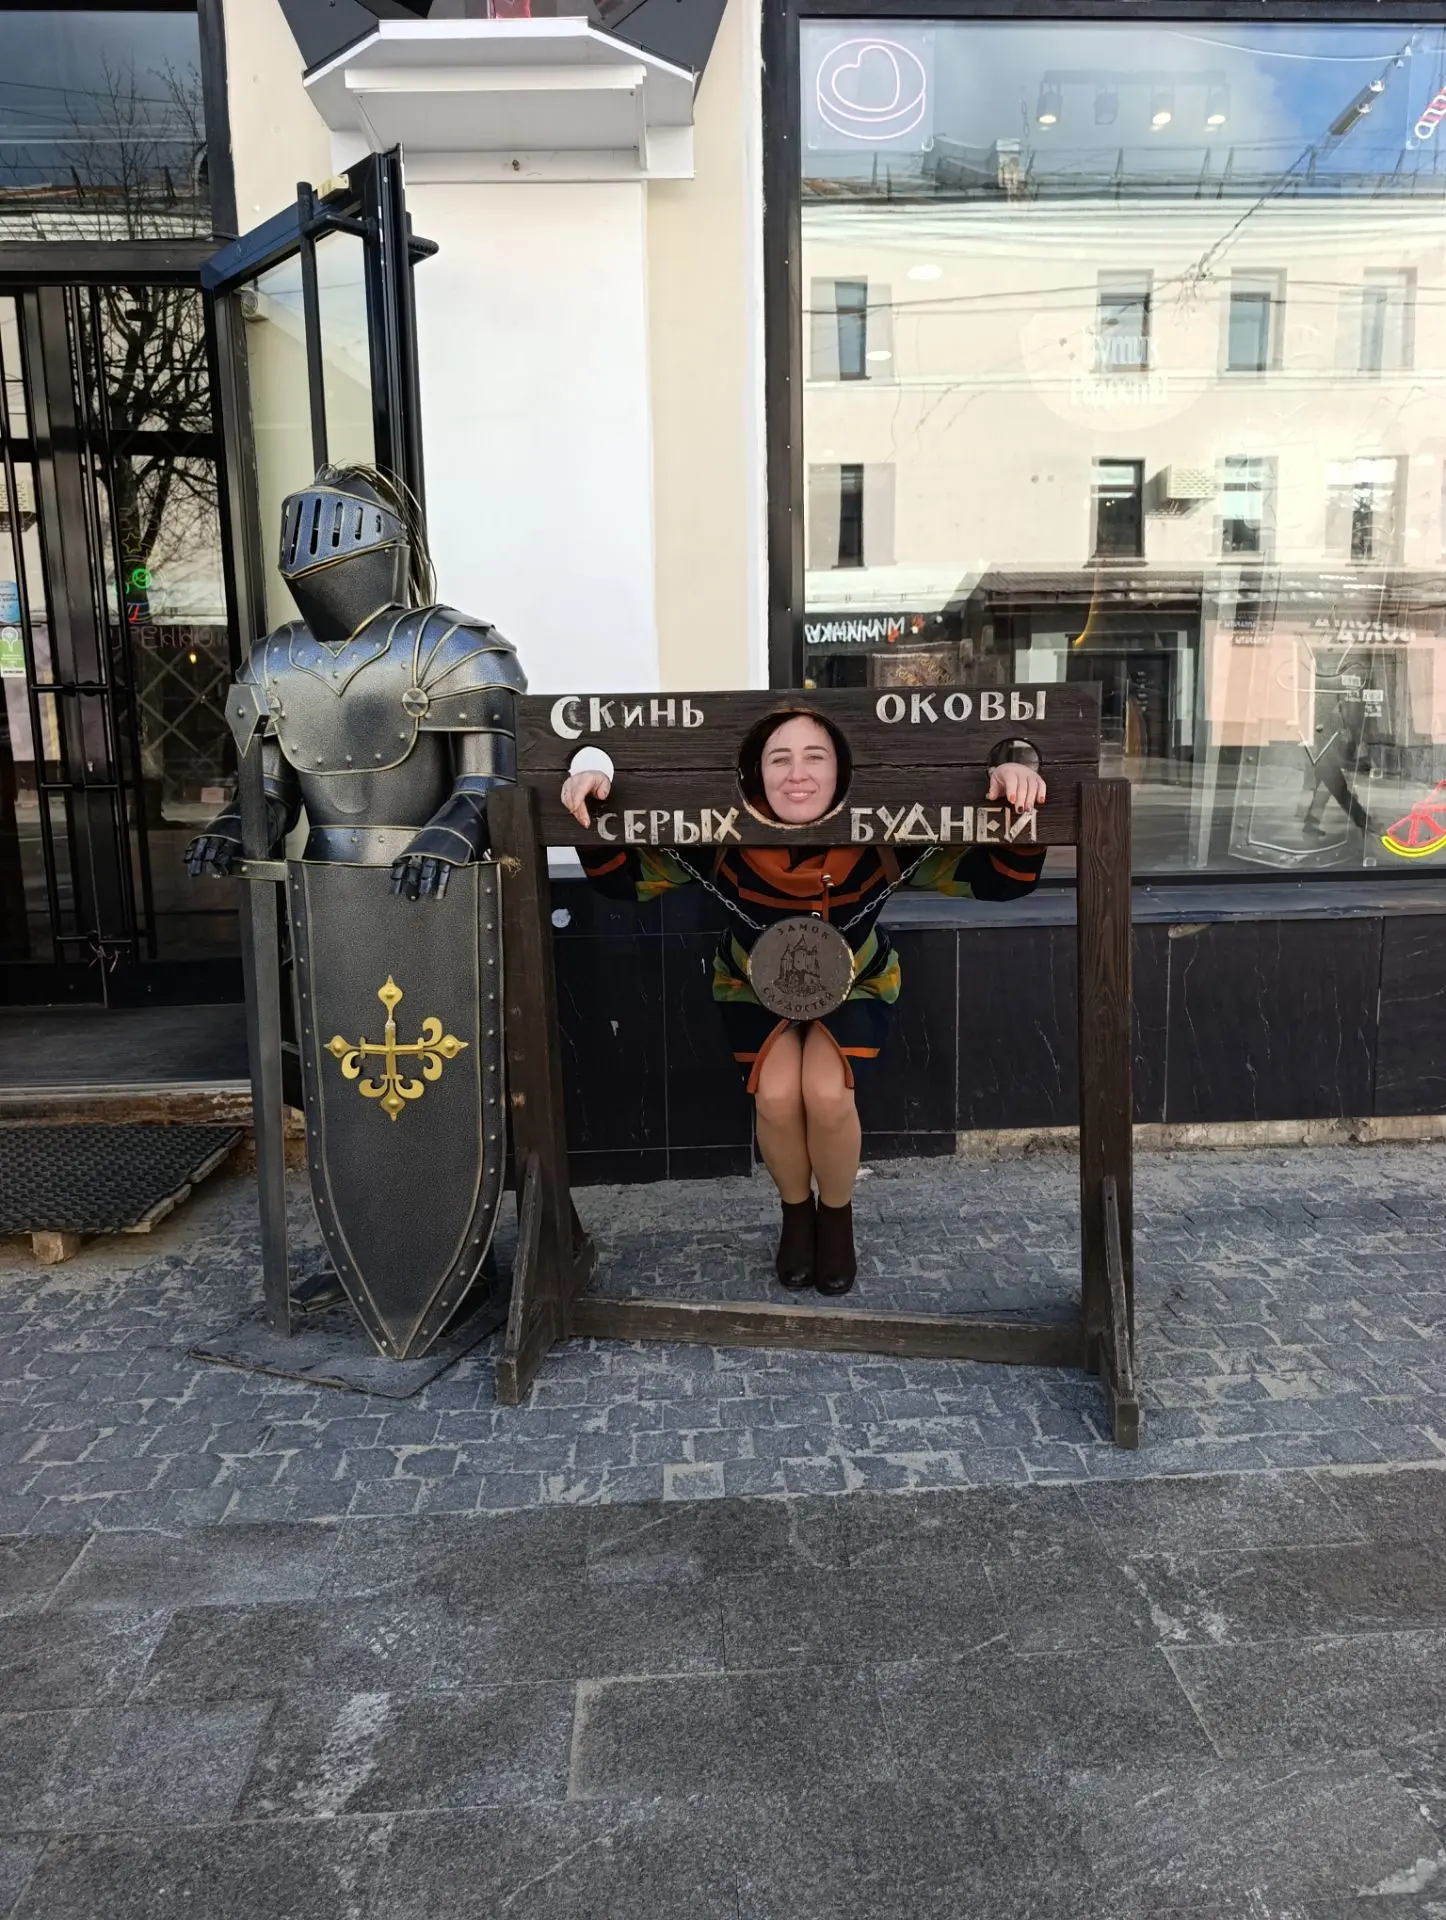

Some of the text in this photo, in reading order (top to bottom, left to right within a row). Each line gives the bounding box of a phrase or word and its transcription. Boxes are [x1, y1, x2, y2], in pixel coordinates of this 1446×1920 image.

[876, 691, 1047, 725] ОКОВЫ
[597, 806, 743, 845] СЕРЫХ
[777, 923, 830, 940] ЗАМОК
